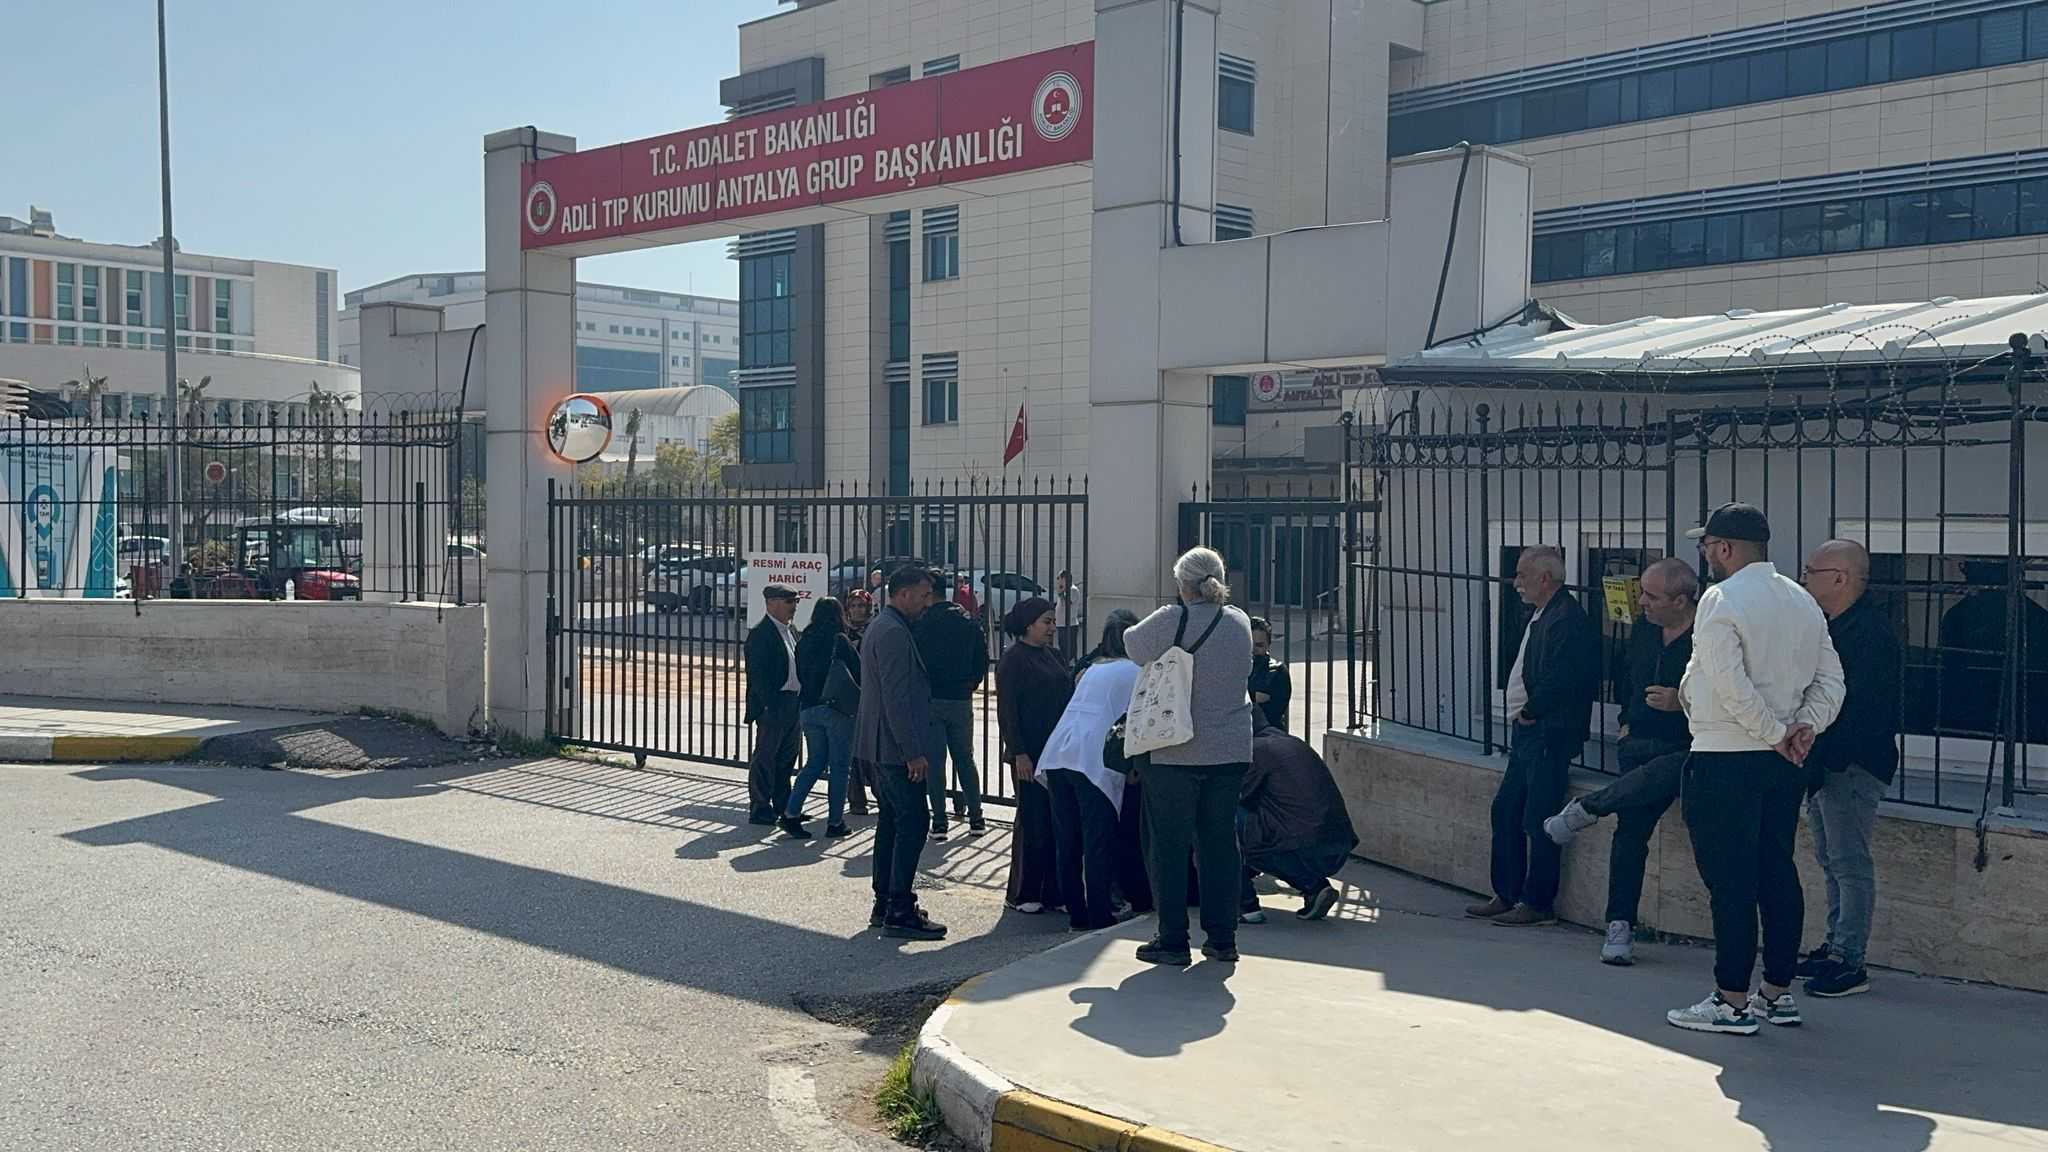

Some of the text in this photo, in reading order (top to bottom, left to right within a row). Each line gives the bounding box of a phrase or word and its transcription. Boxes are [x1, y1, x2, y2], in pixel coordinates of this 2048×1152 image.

[561, 198, 597, 234] ADLİ
[602, 197, 629, 228] TIP
[633, 182, 710, 223] KURUMU
[716, 167, 800, 210] ANTALYA
[806, 154, 864, 194] GRUP
[875, 116, 1023, 187] BAŞKANLIĞI
[650, 97, 875, 177] T.C. ADALET BAKANLIĞI
[753, 557, 822, 572] RESMİ ARAÇ
